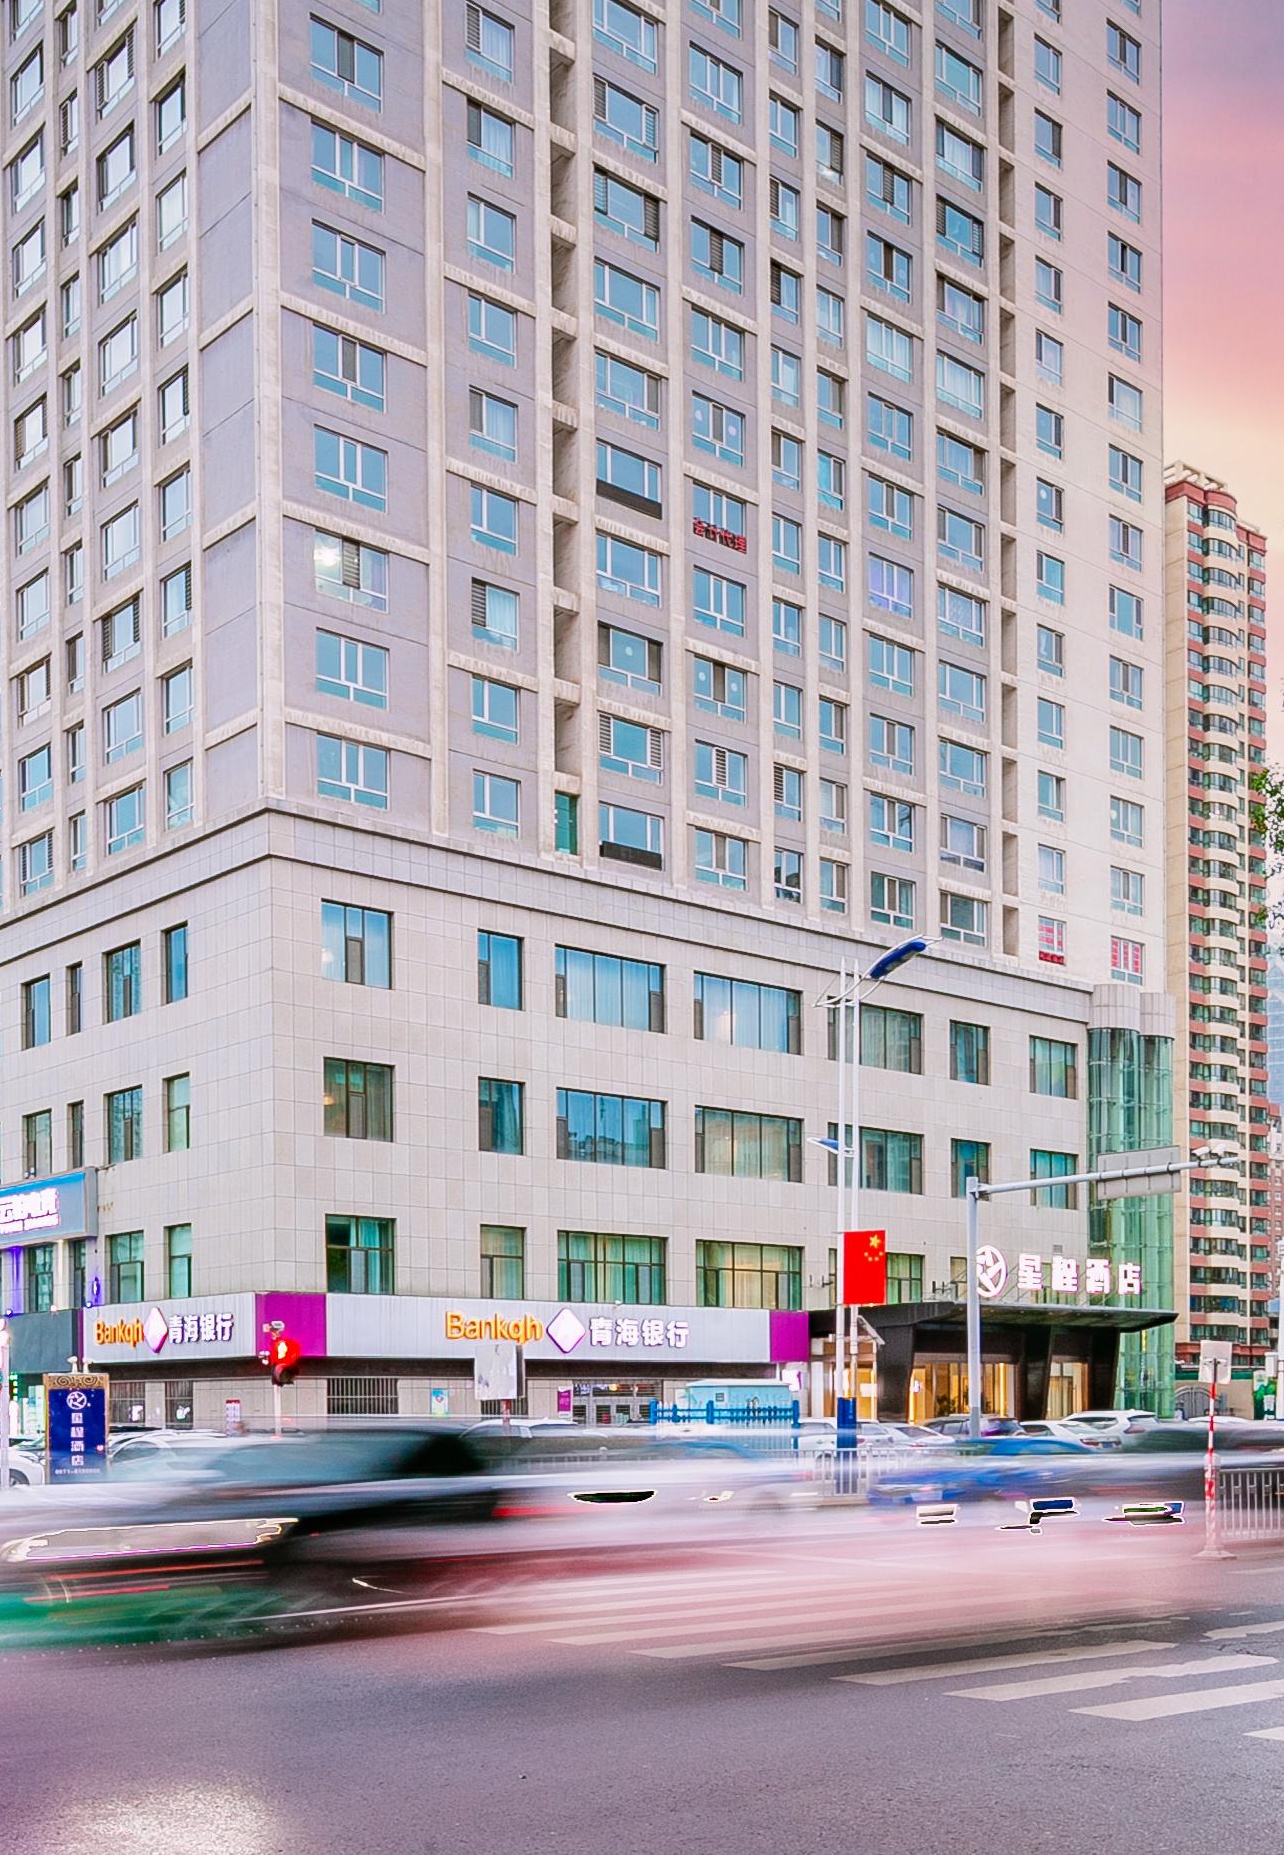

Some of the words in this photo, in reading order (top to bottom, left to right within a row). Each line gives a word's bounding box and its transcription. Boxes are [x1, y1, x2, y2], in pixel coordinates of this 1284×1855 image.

[1017, 1253, 1143, 1295] 星程酒店
[94, 1317, 144, 1348] Bankqh
[168, 1313, 233, 1343] 青海银行
[445, 1312, 543, 1344] Bankqh
[589, 1316, 690, 1348] 青海银行
